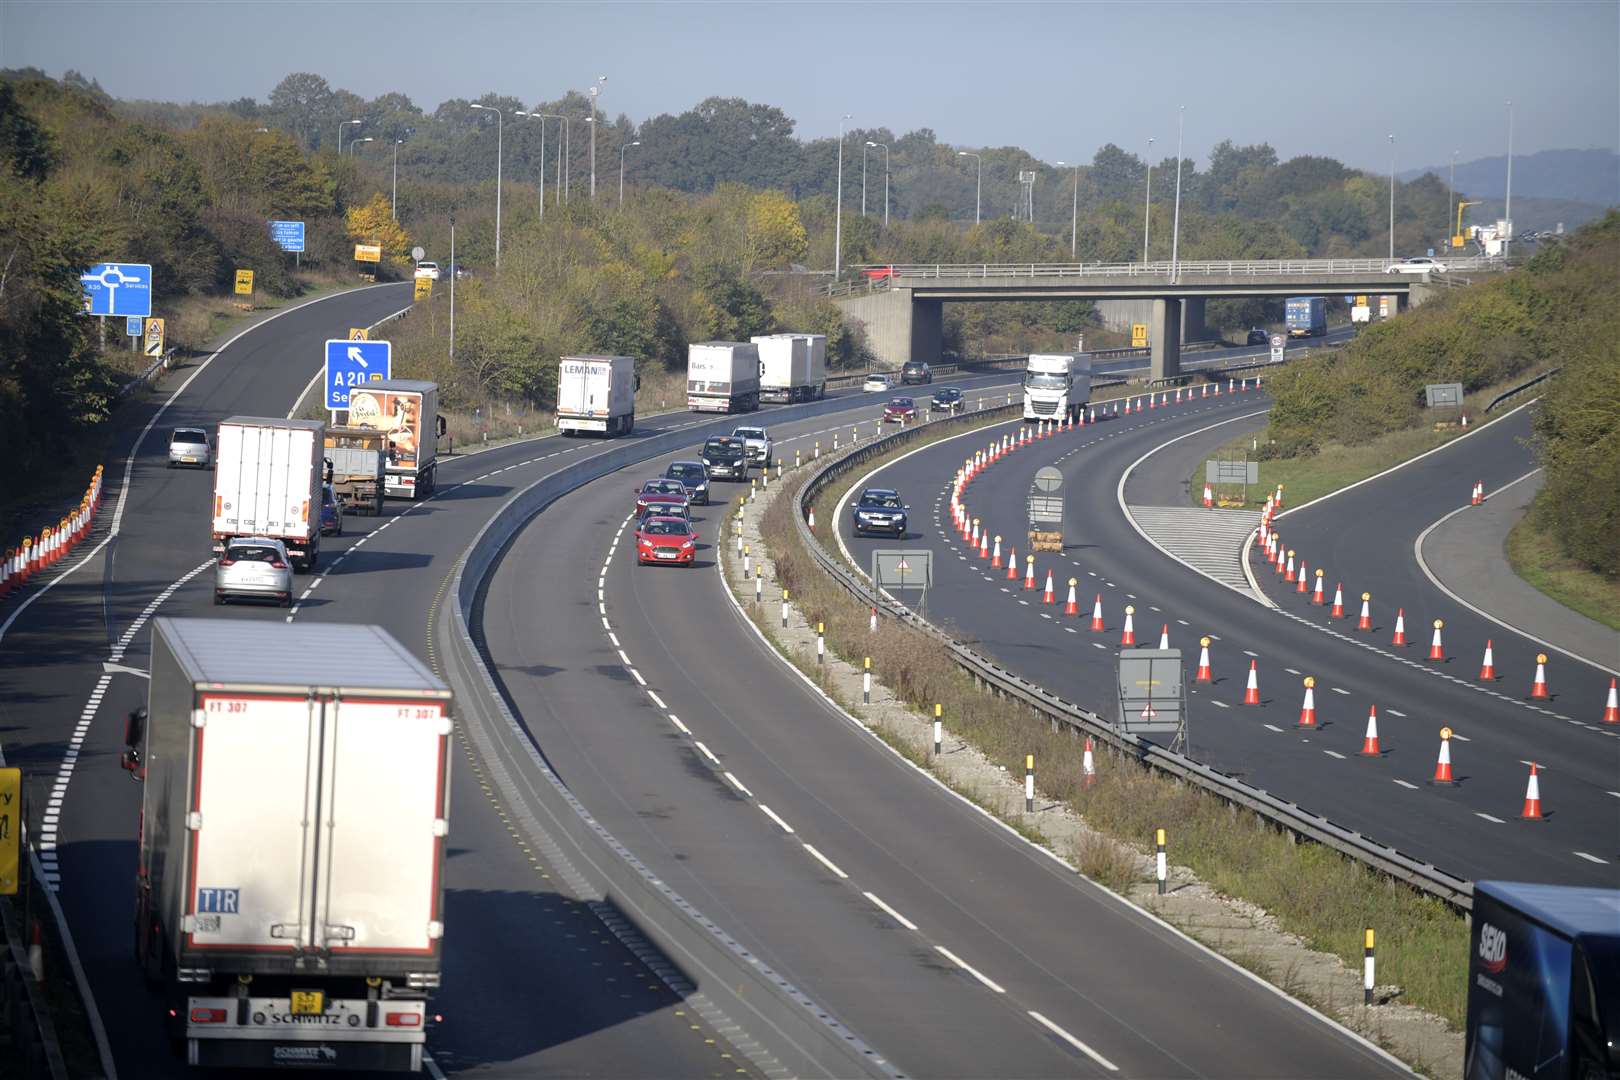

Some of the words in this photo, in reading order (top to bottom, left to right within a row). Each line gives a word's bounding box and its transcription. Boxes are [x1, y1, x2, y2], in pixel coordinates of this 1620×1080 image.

[564, 365, 598, 375] LEMAN
[332, 392, 348, 402] Se
[210, 702, 222, 712] FT
[227, 702, 248, 713] 307
[201, 889, 236, 912] TIR
[1479, 922, 1507, 962] SEKO
